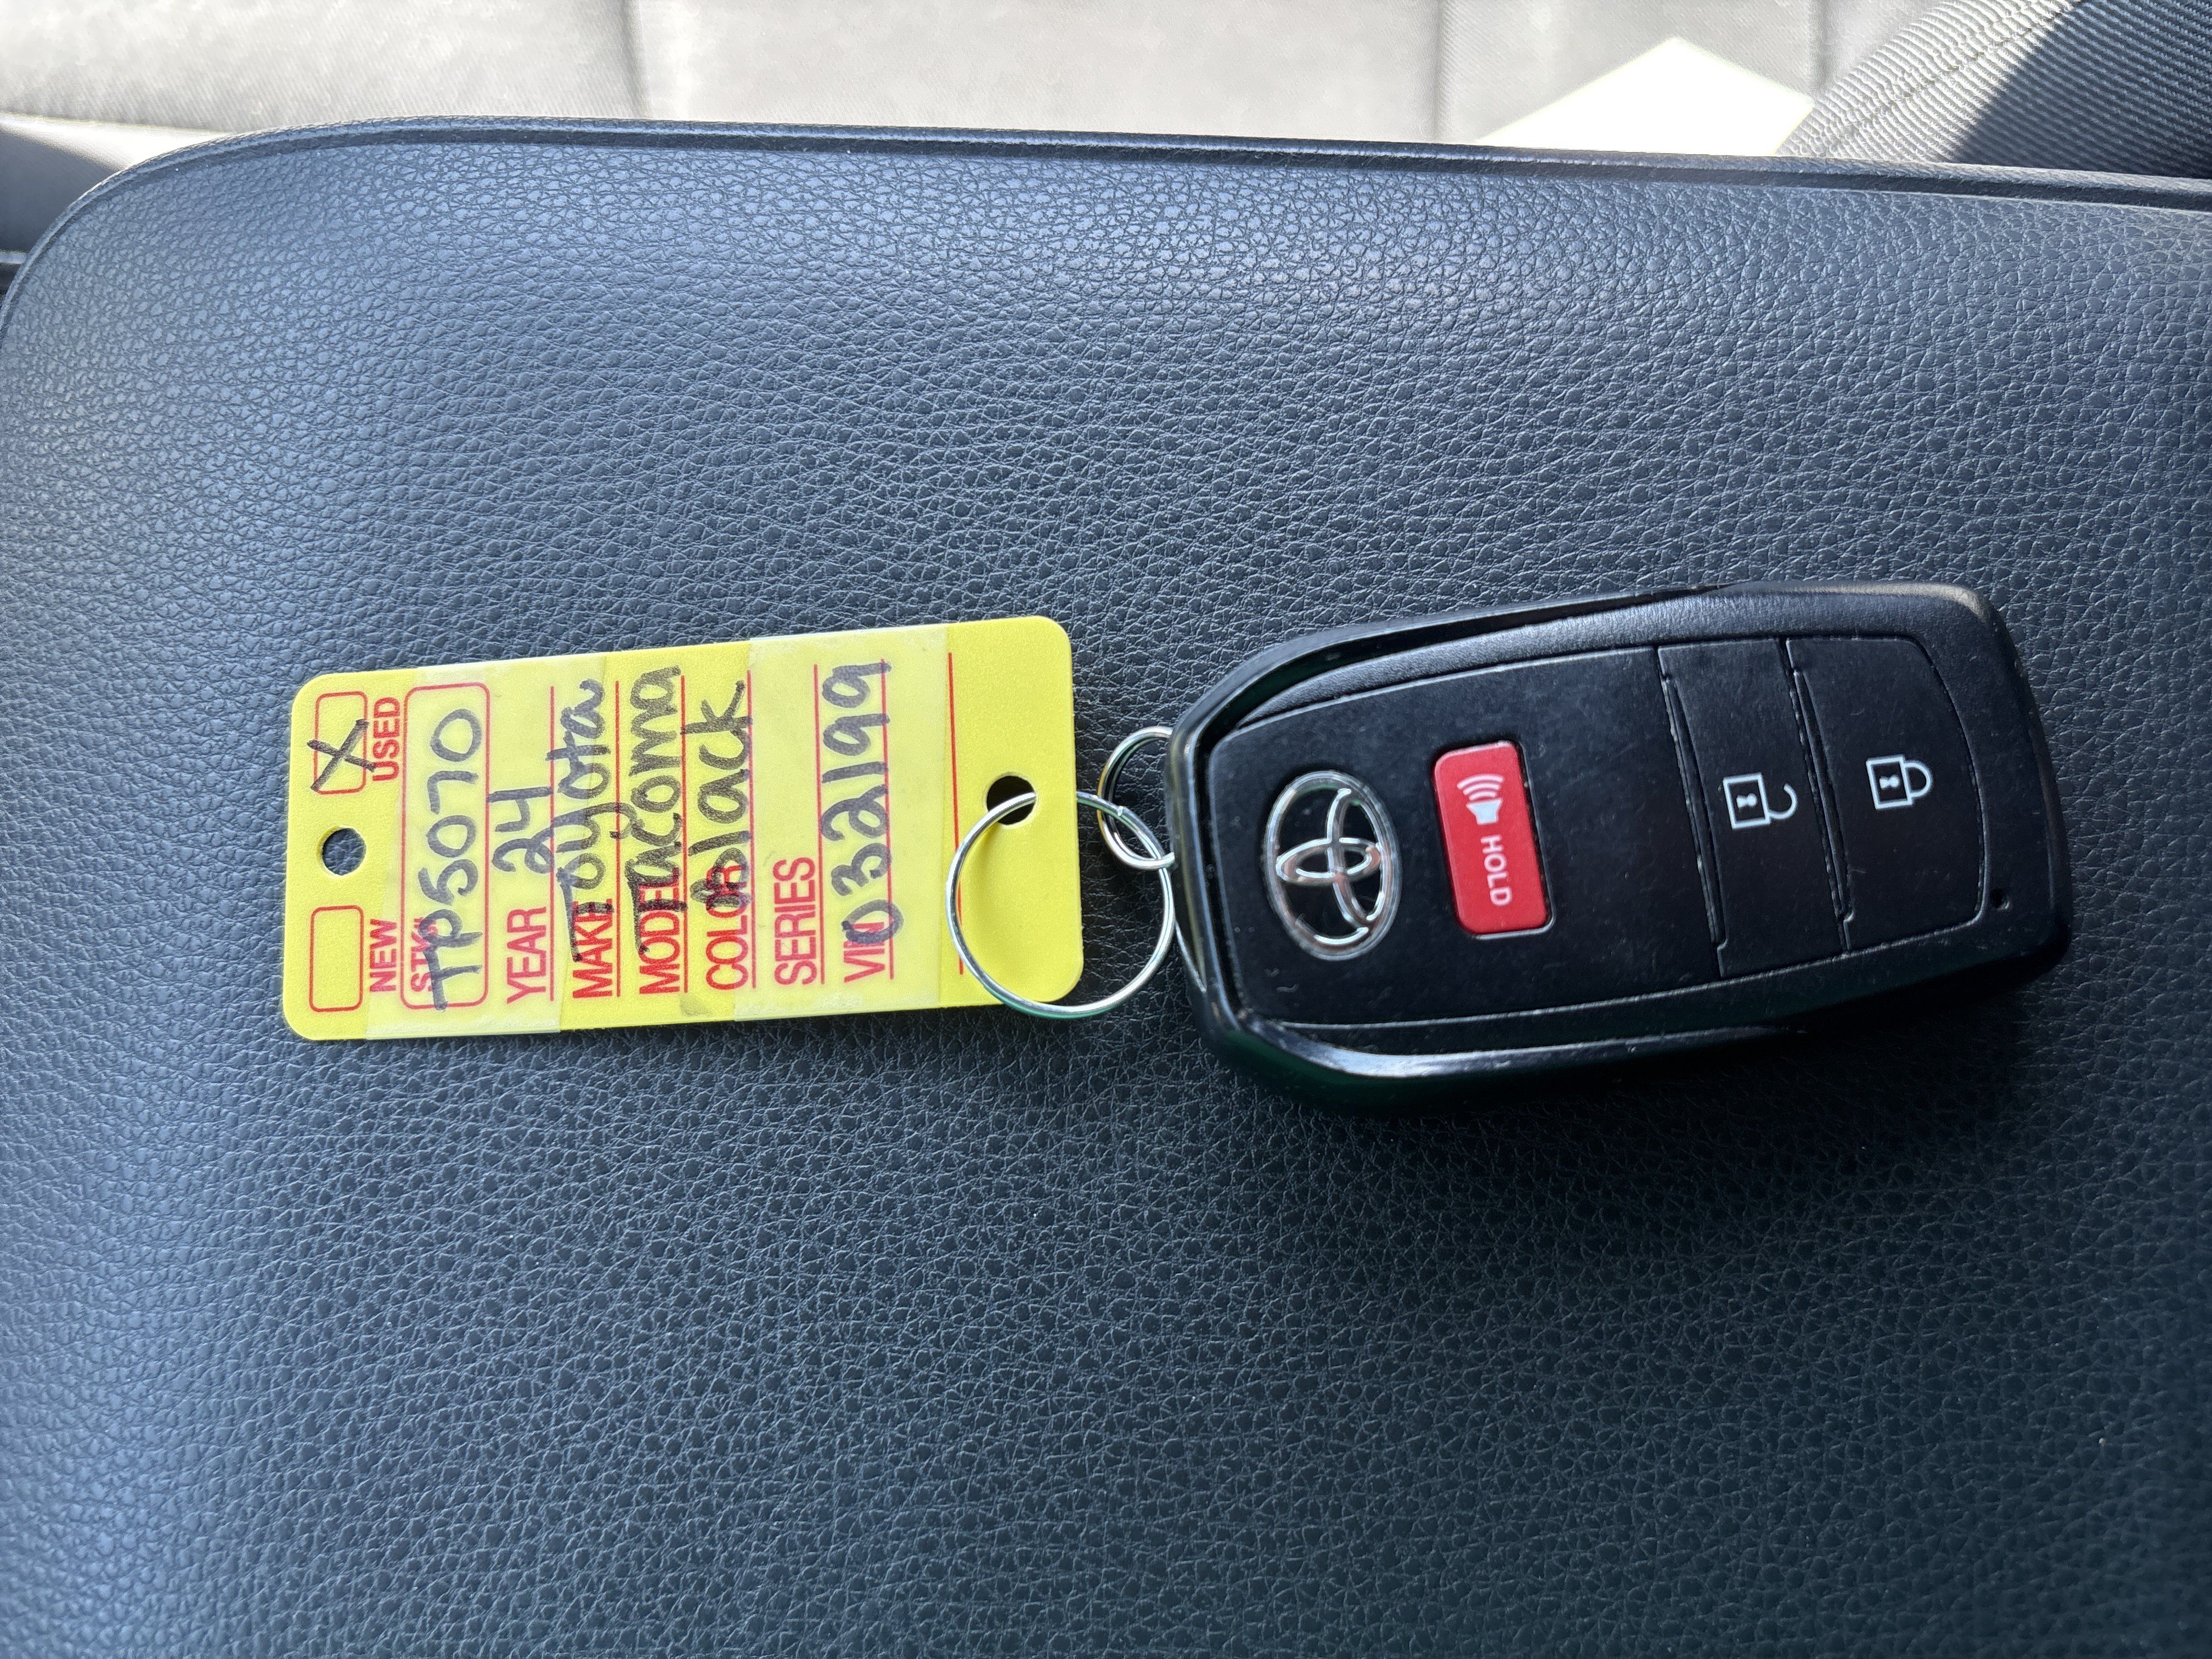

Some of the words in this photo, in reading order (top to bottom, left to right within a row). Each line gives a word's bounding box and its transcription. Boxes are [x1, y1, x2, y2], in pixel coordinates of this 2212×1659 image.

[373, 697, 400, 781] USED
[487, 786, 554, 874] 24
[546, 679, 643, 962] Toyota
[624, 665, 688, 955] Tacoma
[680, 680, 752, 907] Black
[821, 661, 904, 944] 032199
[1481, 834, 1512, 906] HOLD
[369, 918, 397, 992] NEW
[410, 917, 438, 992] STK#
[507, 906, 546, 1004] YEAR
[573, 899, 612, 998] MAKE
[639, 868, 680, 995] MODEL
[706, 866, 748, 990] COLOR
[773, 857, 817, 985] SERIES
[843, 921, 885, 983] VIN
